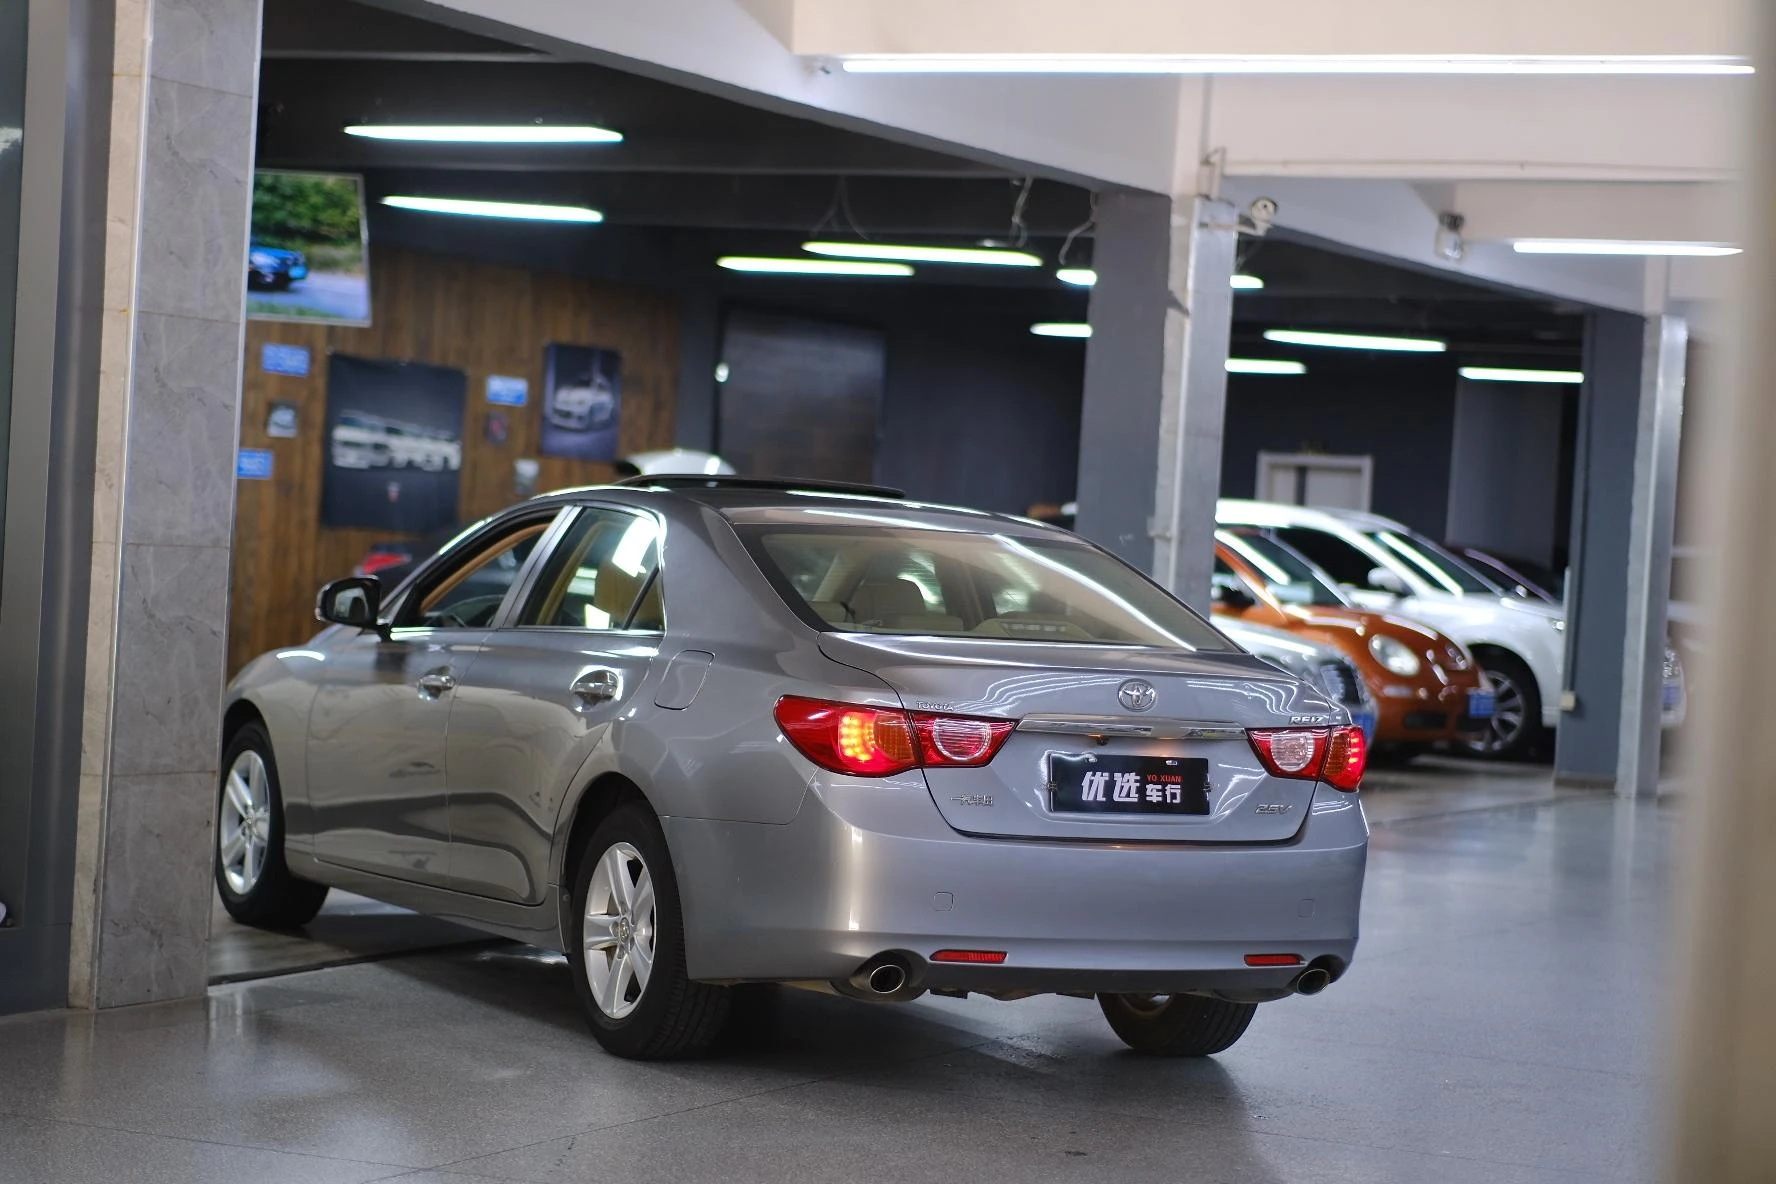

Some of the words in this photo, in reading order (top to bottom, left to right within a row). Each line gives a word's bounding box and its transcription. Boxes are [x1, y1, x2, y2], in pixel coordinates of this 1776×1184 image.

[916, 701, 954, 711] TOYOTA
[1288, 715, 1325, 726] REIZ
[1146, 774, 1158, 782] YO
[1160, 774, 1182, 783] XUAN
[1081, 771, 1141, 802] 优选
[1145, 784, 1182, 803] 车行
